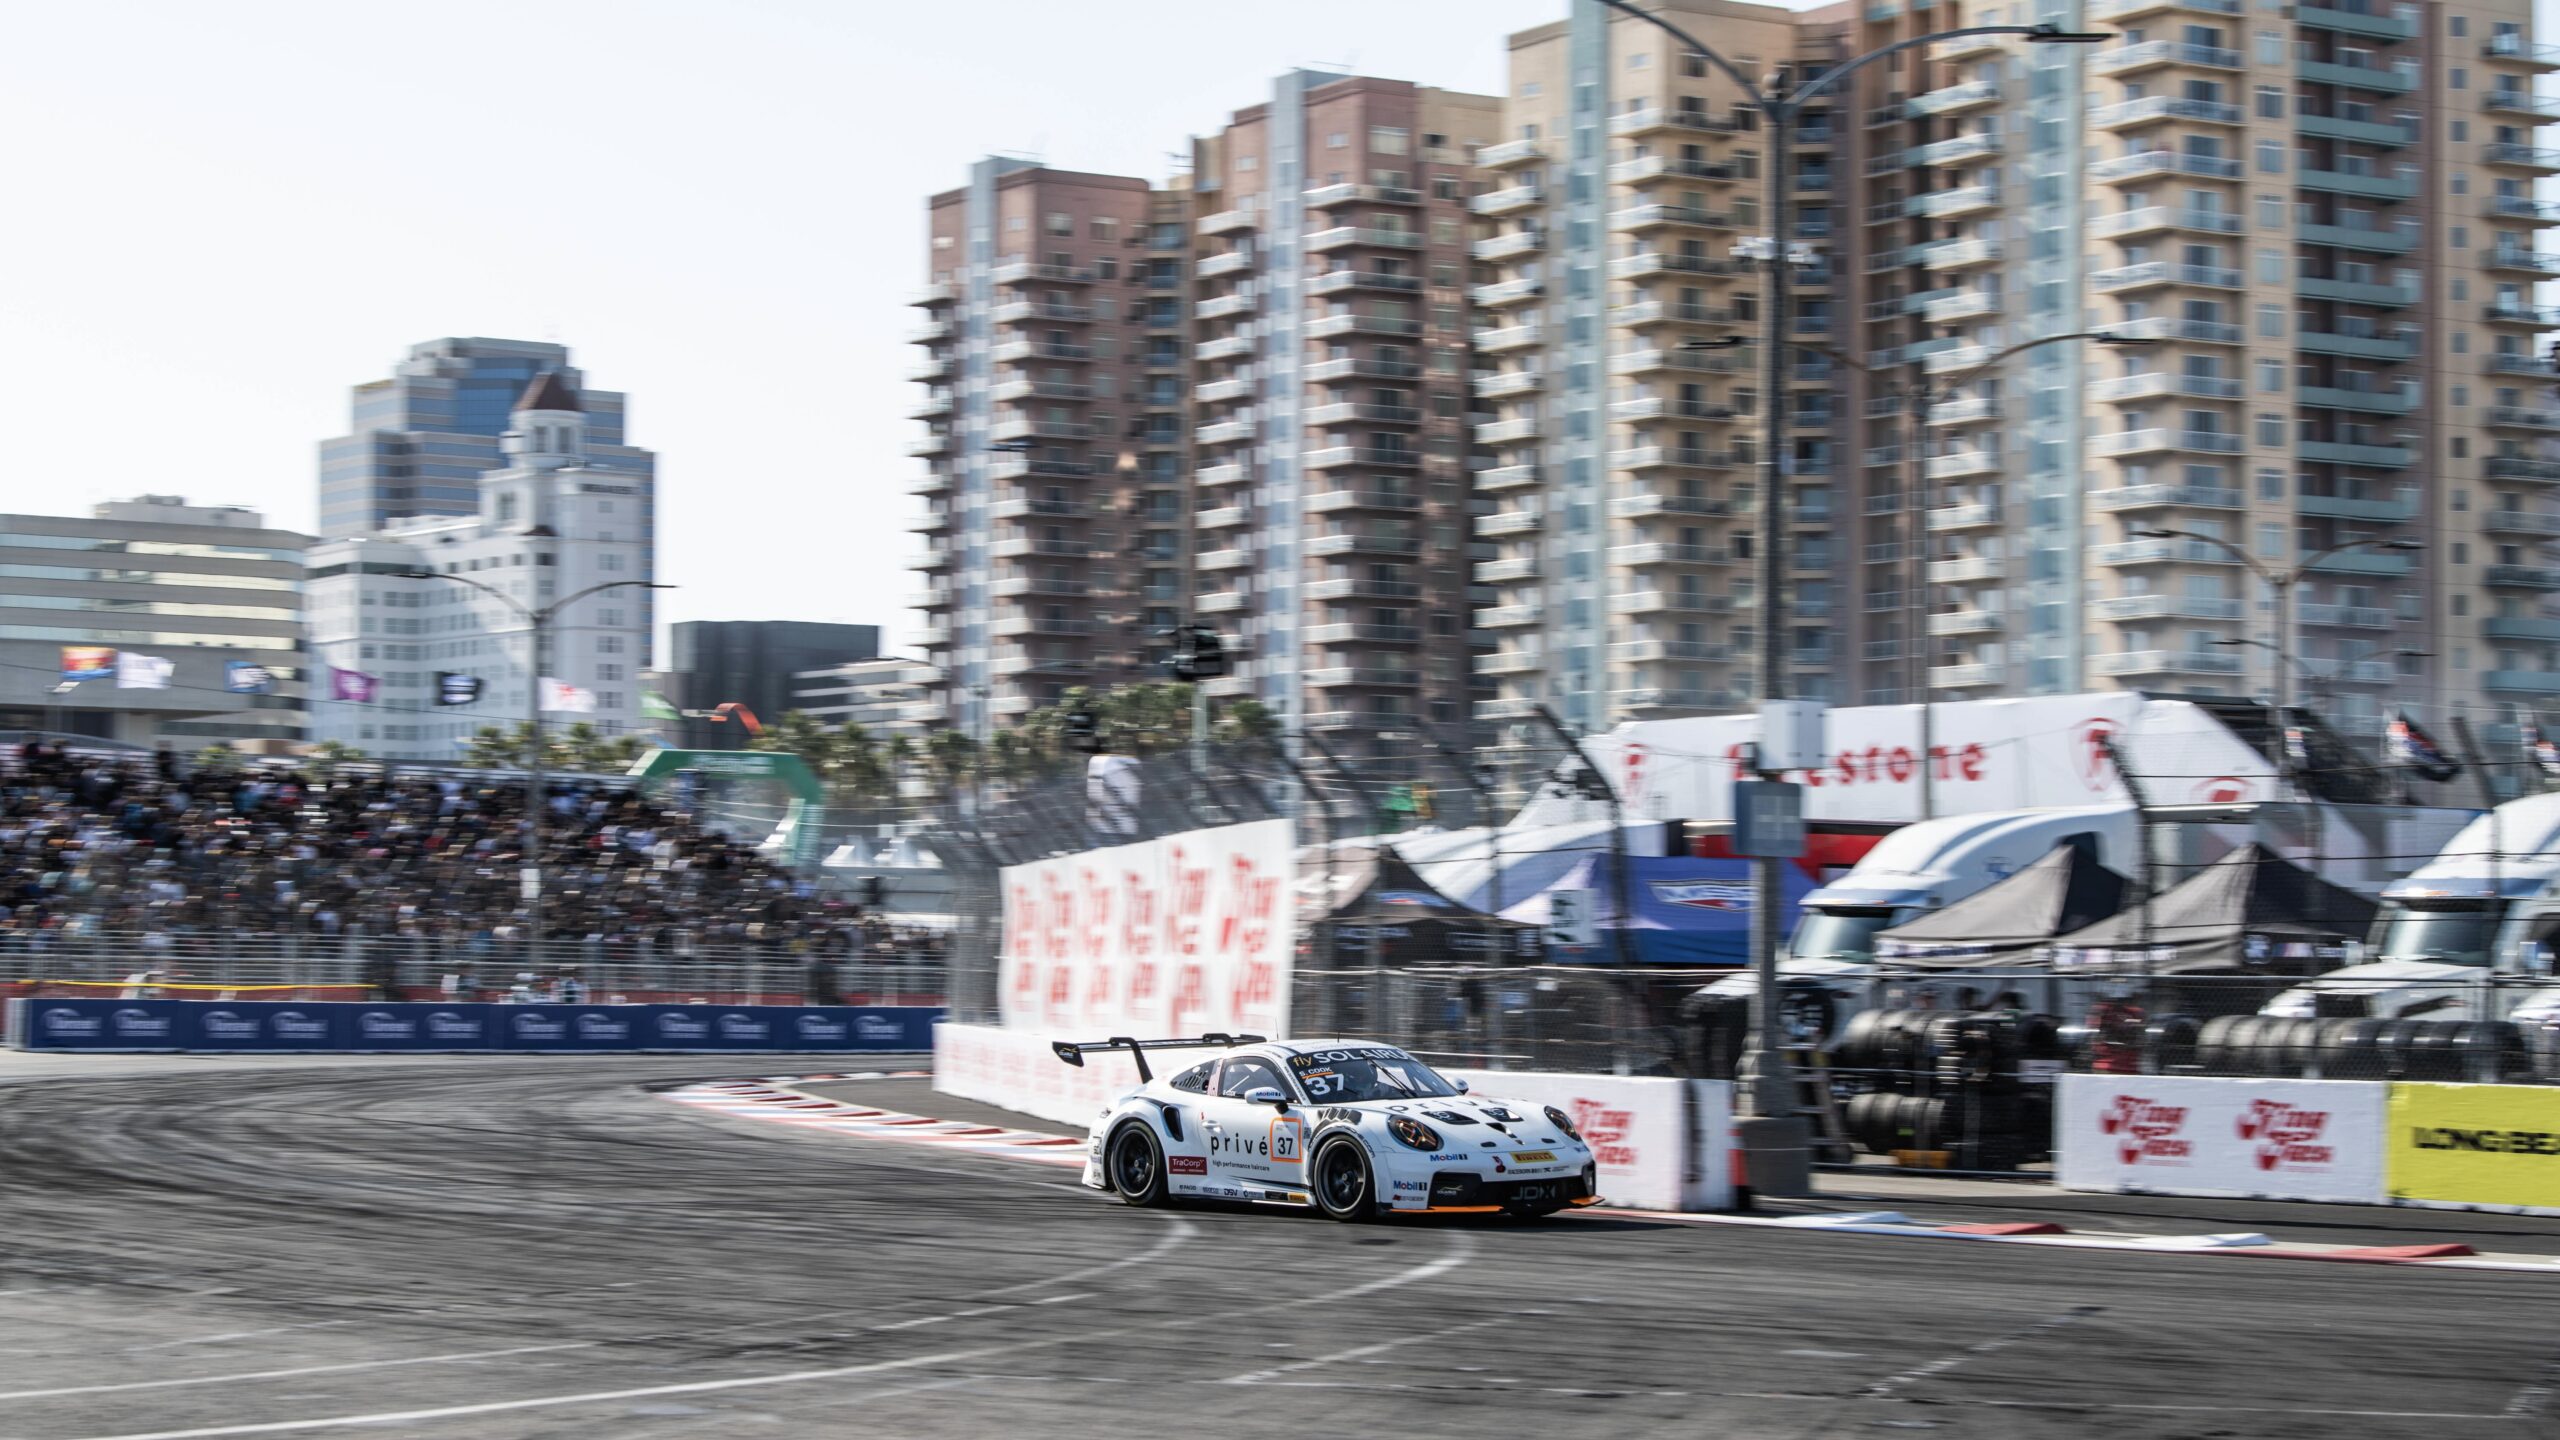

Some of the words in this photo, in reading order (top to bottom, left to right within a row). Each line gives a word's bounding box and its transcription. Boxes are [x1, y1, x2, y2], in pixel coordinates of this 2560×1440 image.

[1725, 742, 1985, 786] stone
[1293, 1055, 1312, 1067] fly
[1305, 1074, 1345, 1096] 37
[1210, 1133, 1268, 1155] privé
[1277, 1137, 1293, 1155] 37
[1172, 1158, 1201, 1167] TraCorp
[1429, 1154, 1458, 1162] Mobil
[1222, 1161, 1251, 1170] performance
[1393, 1180, 1418, 1190] Mobil
